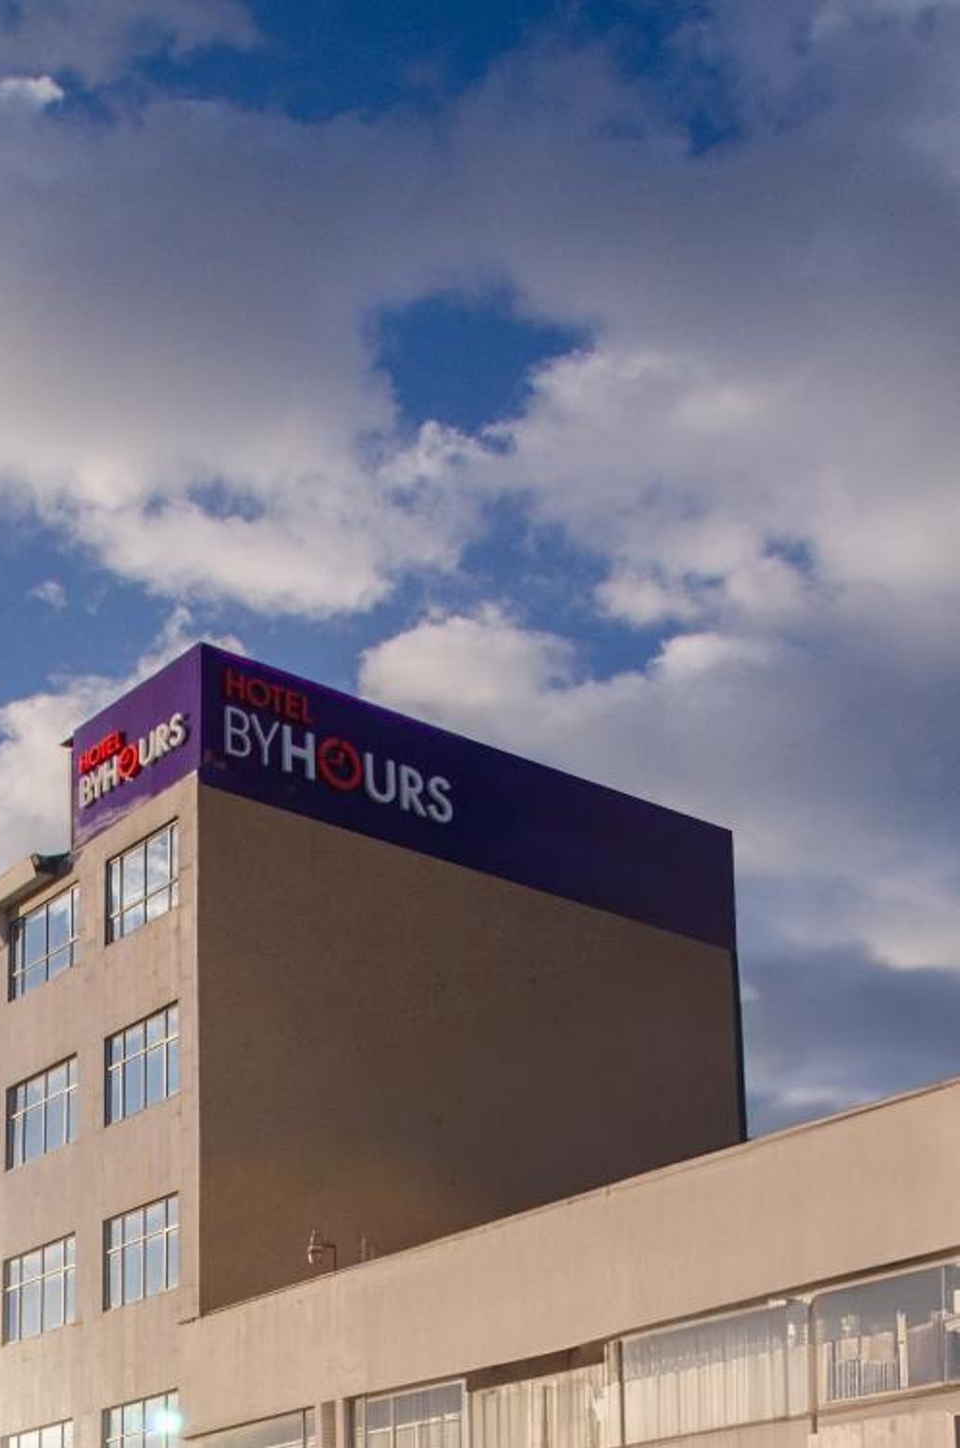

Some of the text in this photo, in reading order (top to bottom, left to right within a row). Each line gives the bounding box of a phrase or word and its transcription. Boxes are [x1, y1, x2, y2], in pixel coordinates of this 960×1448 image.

[225, 669, 313, 724] HOTEL
[79, 731, 121, 773] HOTEL
[79, 712, 186, 808] BYHOURS
[224, 705, 453, 823] BYHOURS
